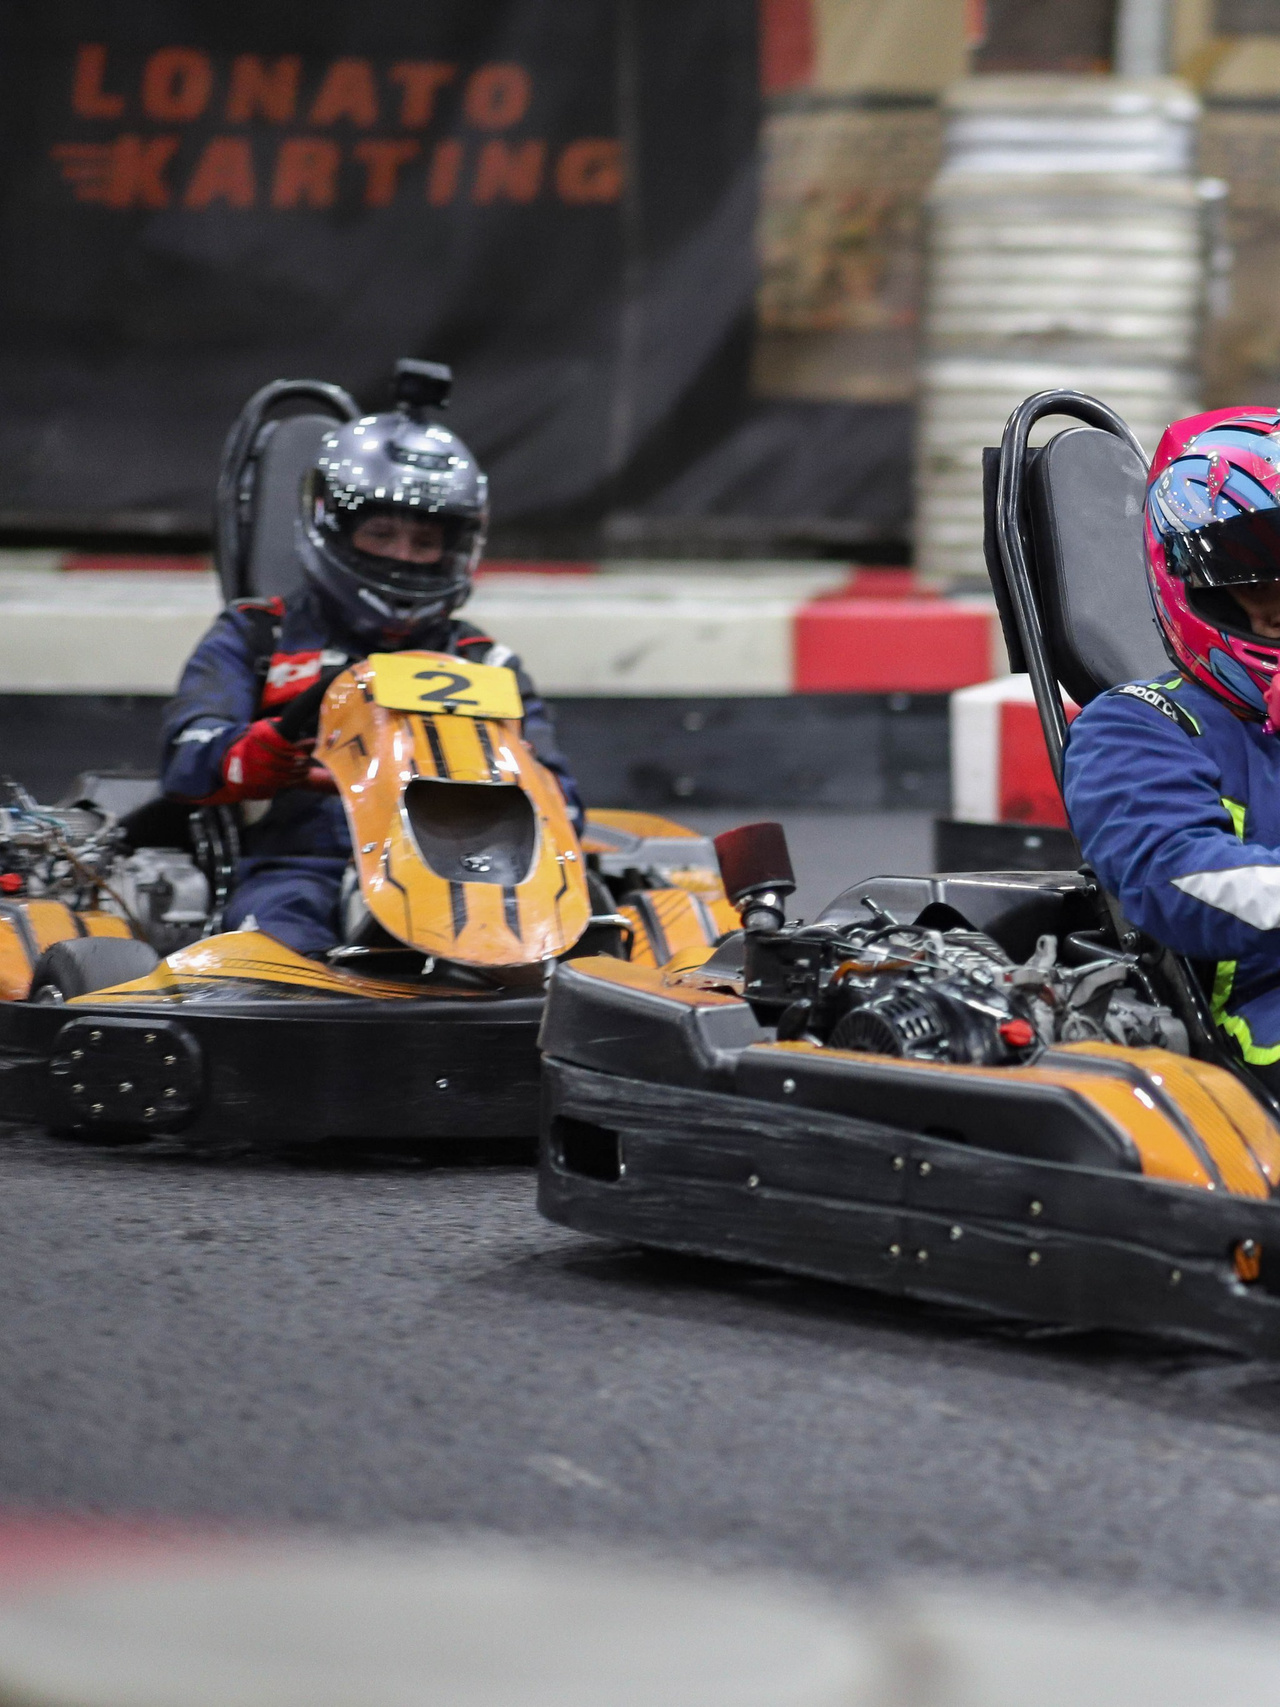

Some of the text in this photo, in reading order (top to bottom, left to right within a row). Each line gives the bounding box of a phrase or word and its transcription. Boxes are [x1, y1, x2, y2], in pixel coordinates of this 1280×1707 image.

[72, 44, 532, 131] LONATO
[104, 134, 624, 211] KARTING
[413, 670, 479, 706] 2
[1118, 685, 1179, 722] sparc
